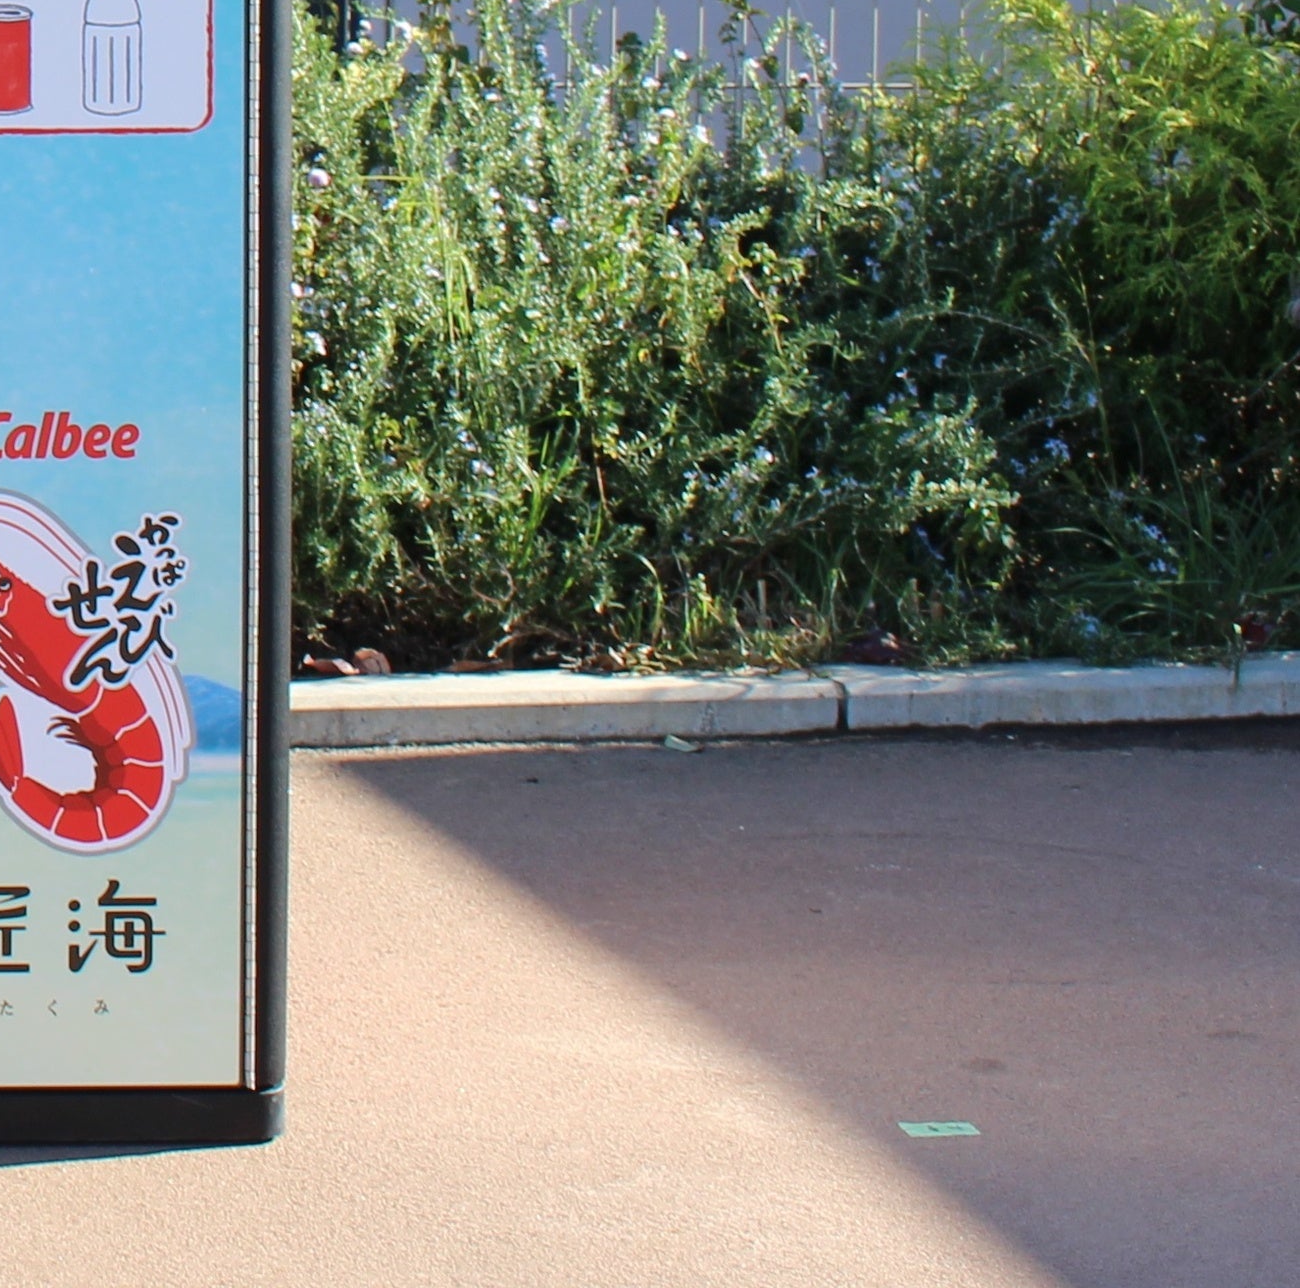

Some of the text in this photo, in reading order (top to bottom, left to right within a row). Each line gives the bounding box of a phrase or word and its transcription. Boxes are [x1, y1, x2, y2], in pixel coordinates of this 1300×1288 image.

[138, 515, 186, 588] かっぱ
[0, 999, 109, 1017] たくみ
